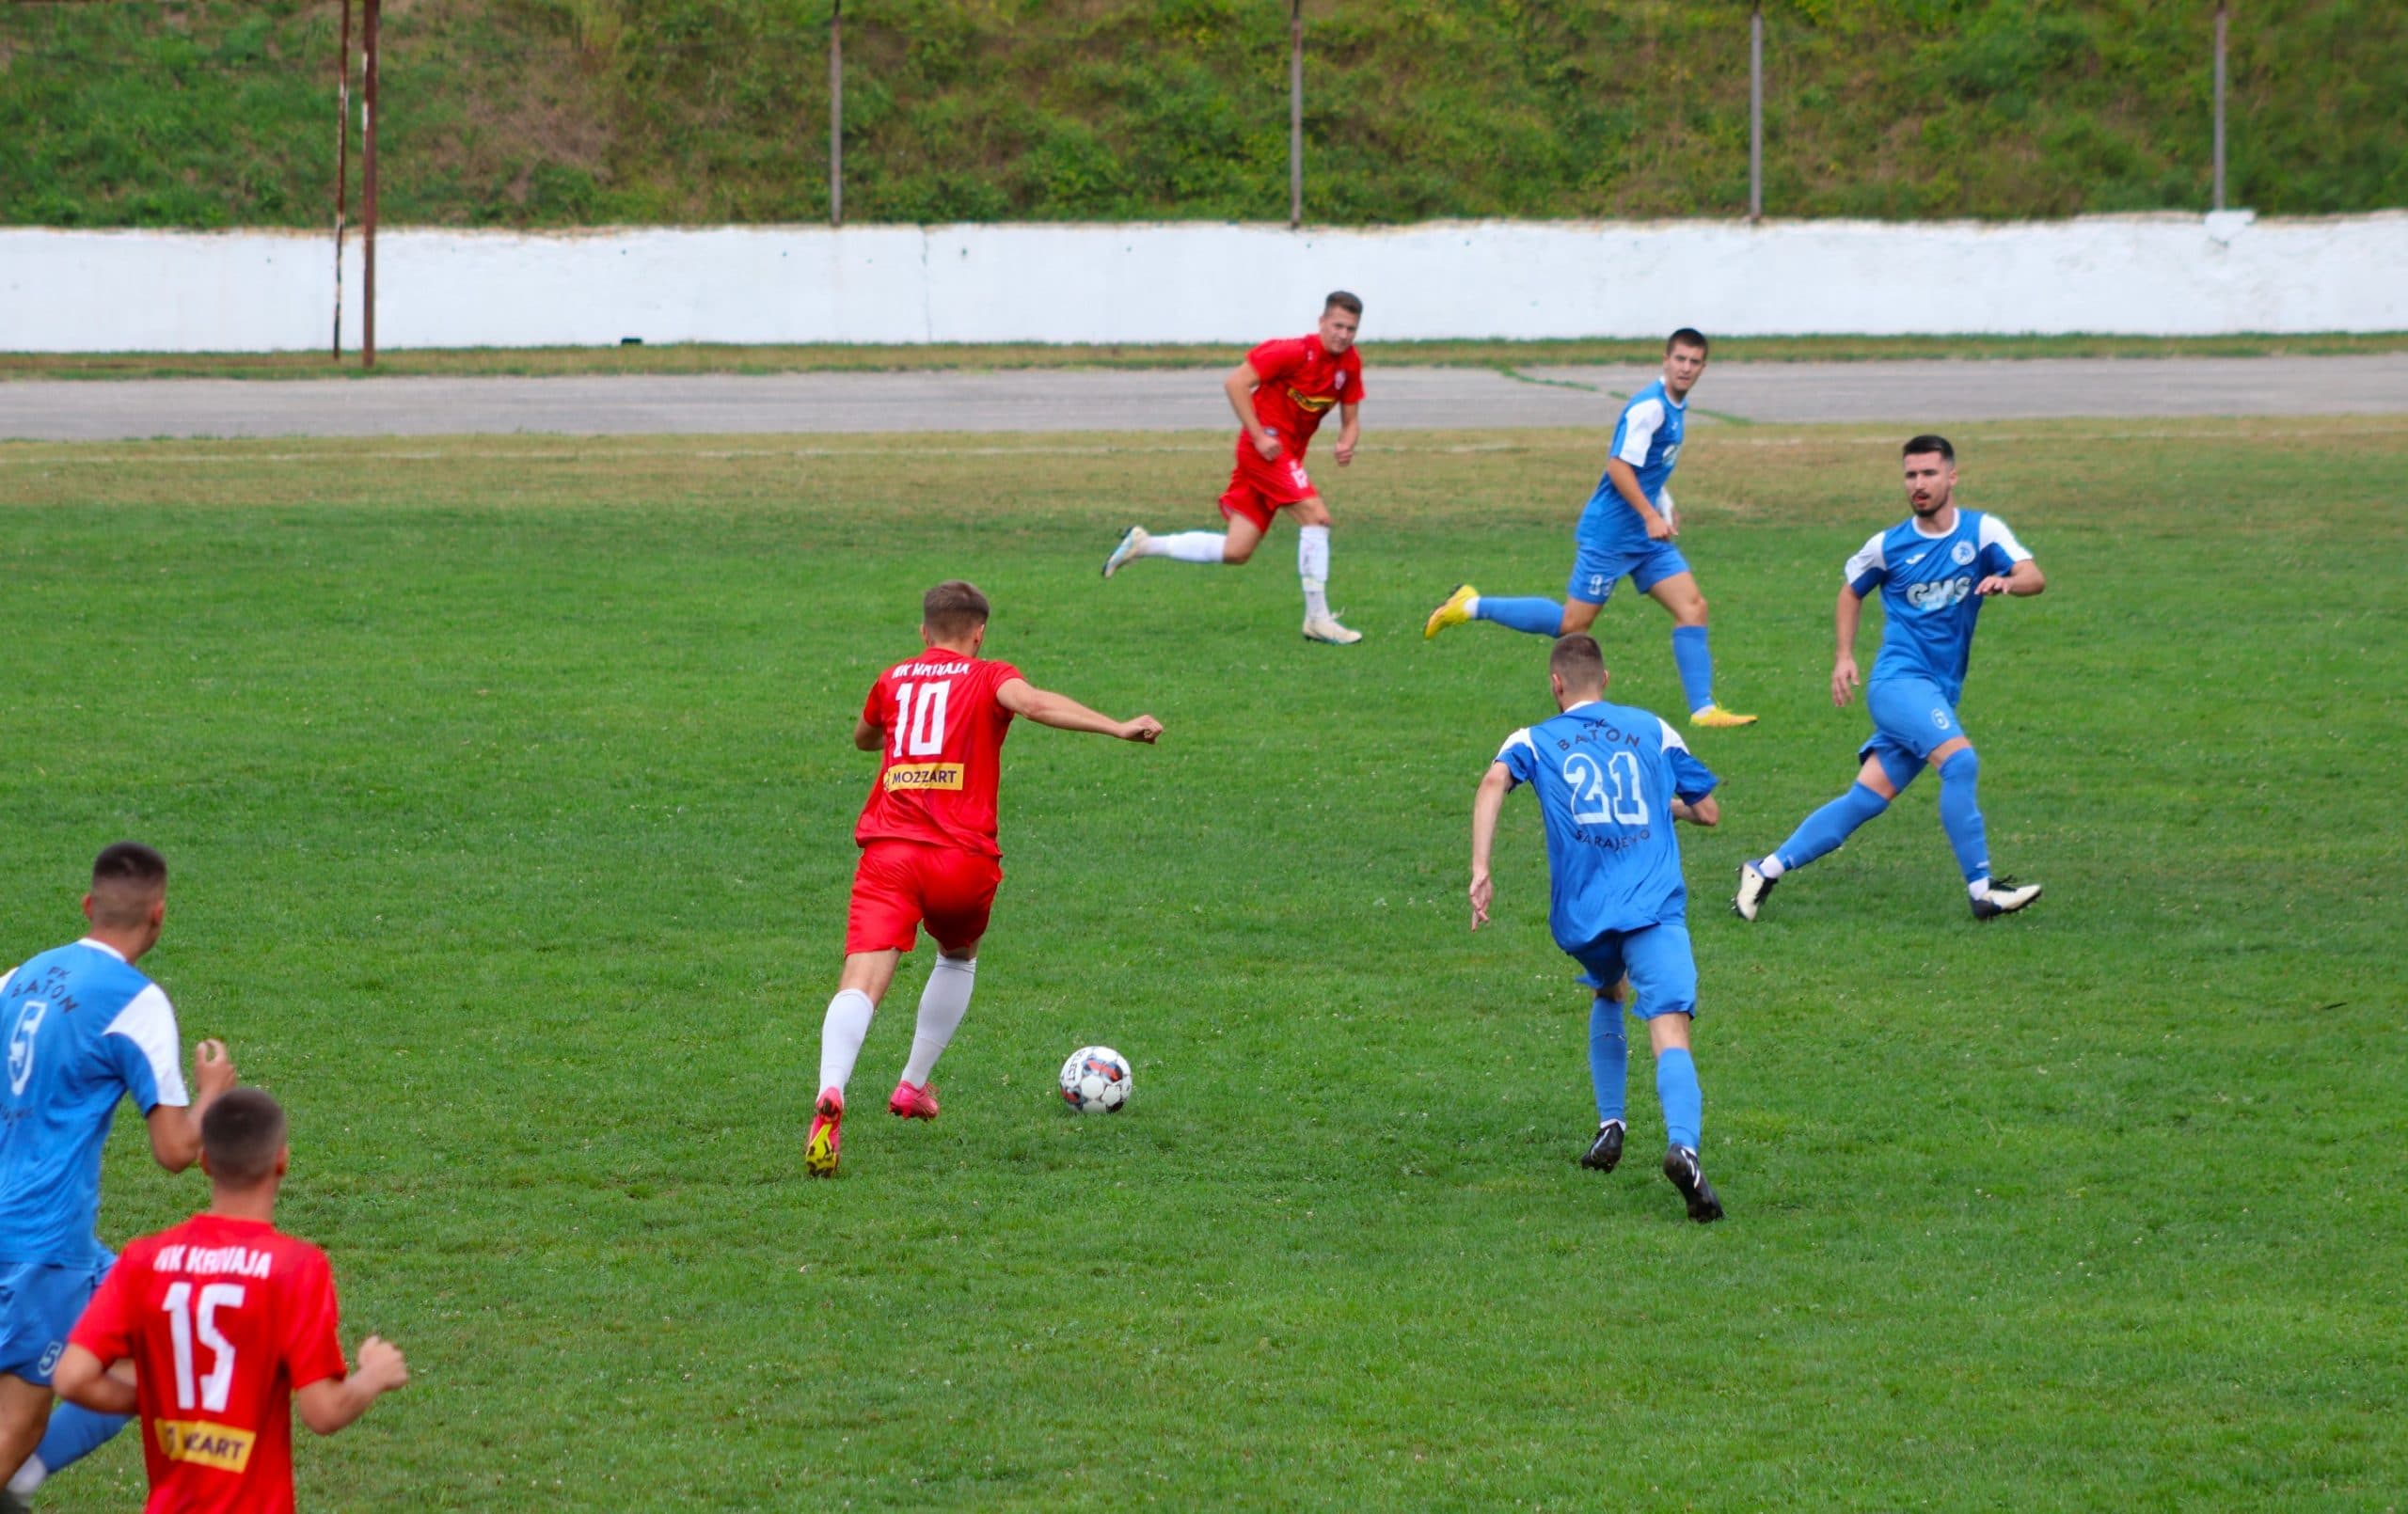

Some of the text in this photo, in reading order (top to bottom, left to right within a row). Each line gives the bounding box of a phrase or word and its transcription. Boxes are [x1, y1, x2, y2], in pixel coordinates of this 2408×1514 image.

[893, 683, 952, 759] 10
[1556, 727, 1641, 751] BATON
[892, 770, 958, 785] MOZZART
[1562, 751, 1649, 825] 21
[1575, 828, 1651, 852] SARAJEVO
[10, 979, 80, 1014] BATON
[153, 1244, 187, 1272] NK
[38, 1340, 62, 1377] 5
[162, 1281, 246, 1413] 15
